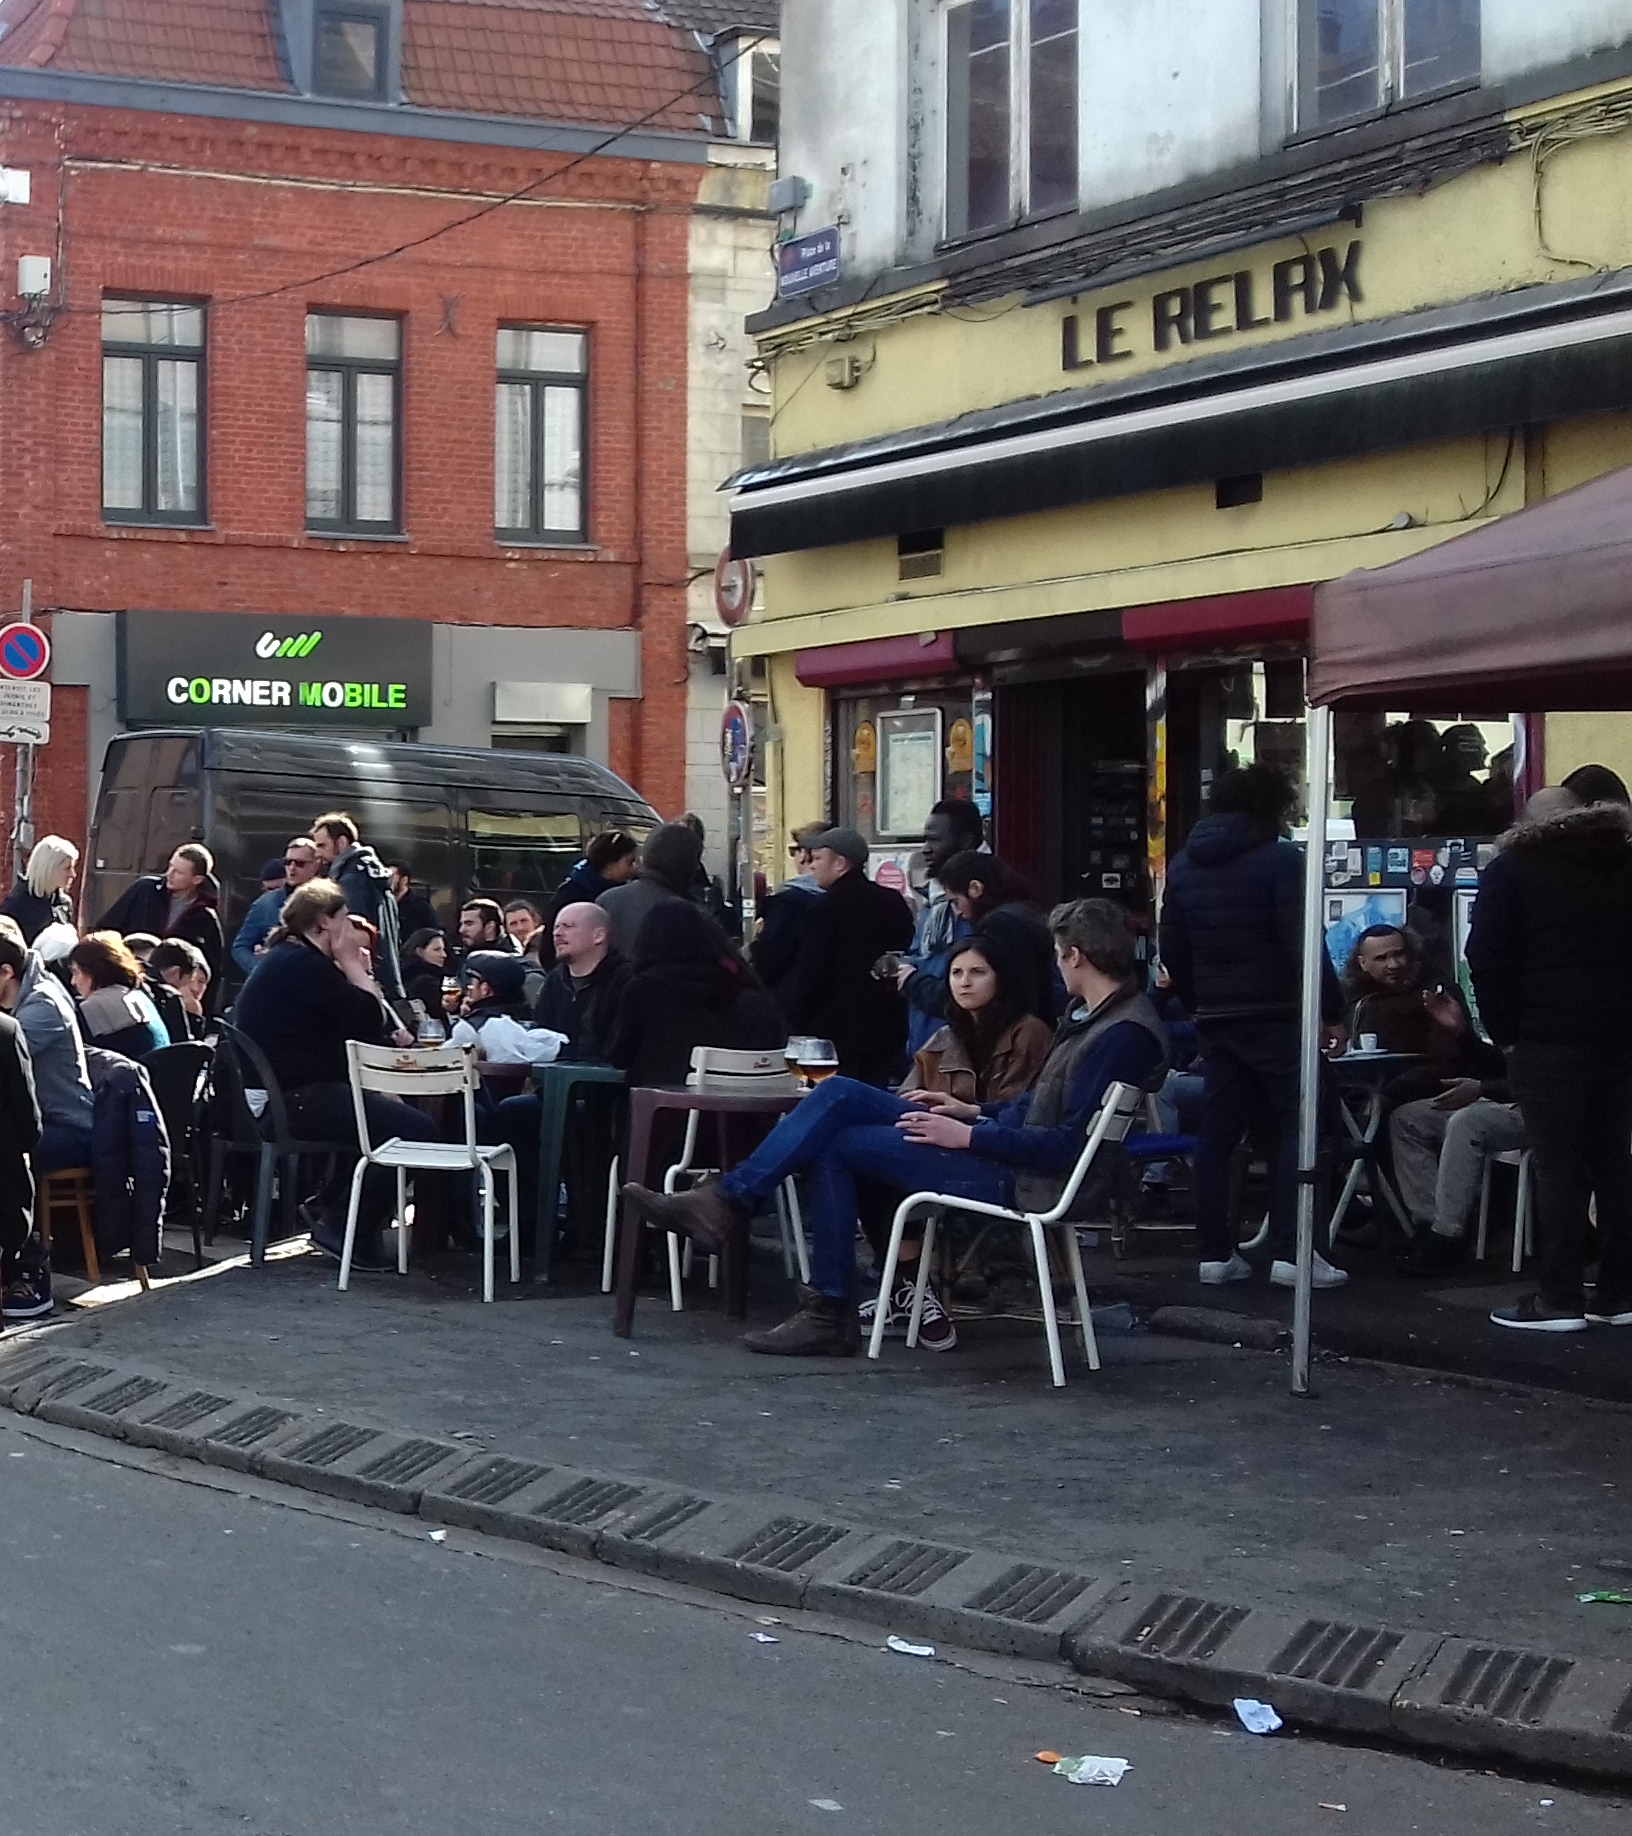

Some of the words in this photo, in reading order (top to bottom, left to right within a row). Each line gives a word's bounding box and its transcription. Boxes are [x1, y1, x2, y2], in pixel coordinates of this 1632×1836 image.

[1060, 300, 1136, 372] LE
[1152, 239, 1364, 352] RELAX
[167, 676, 292, 706] CORNER
[299, 681, 408, 709] MOBILE
